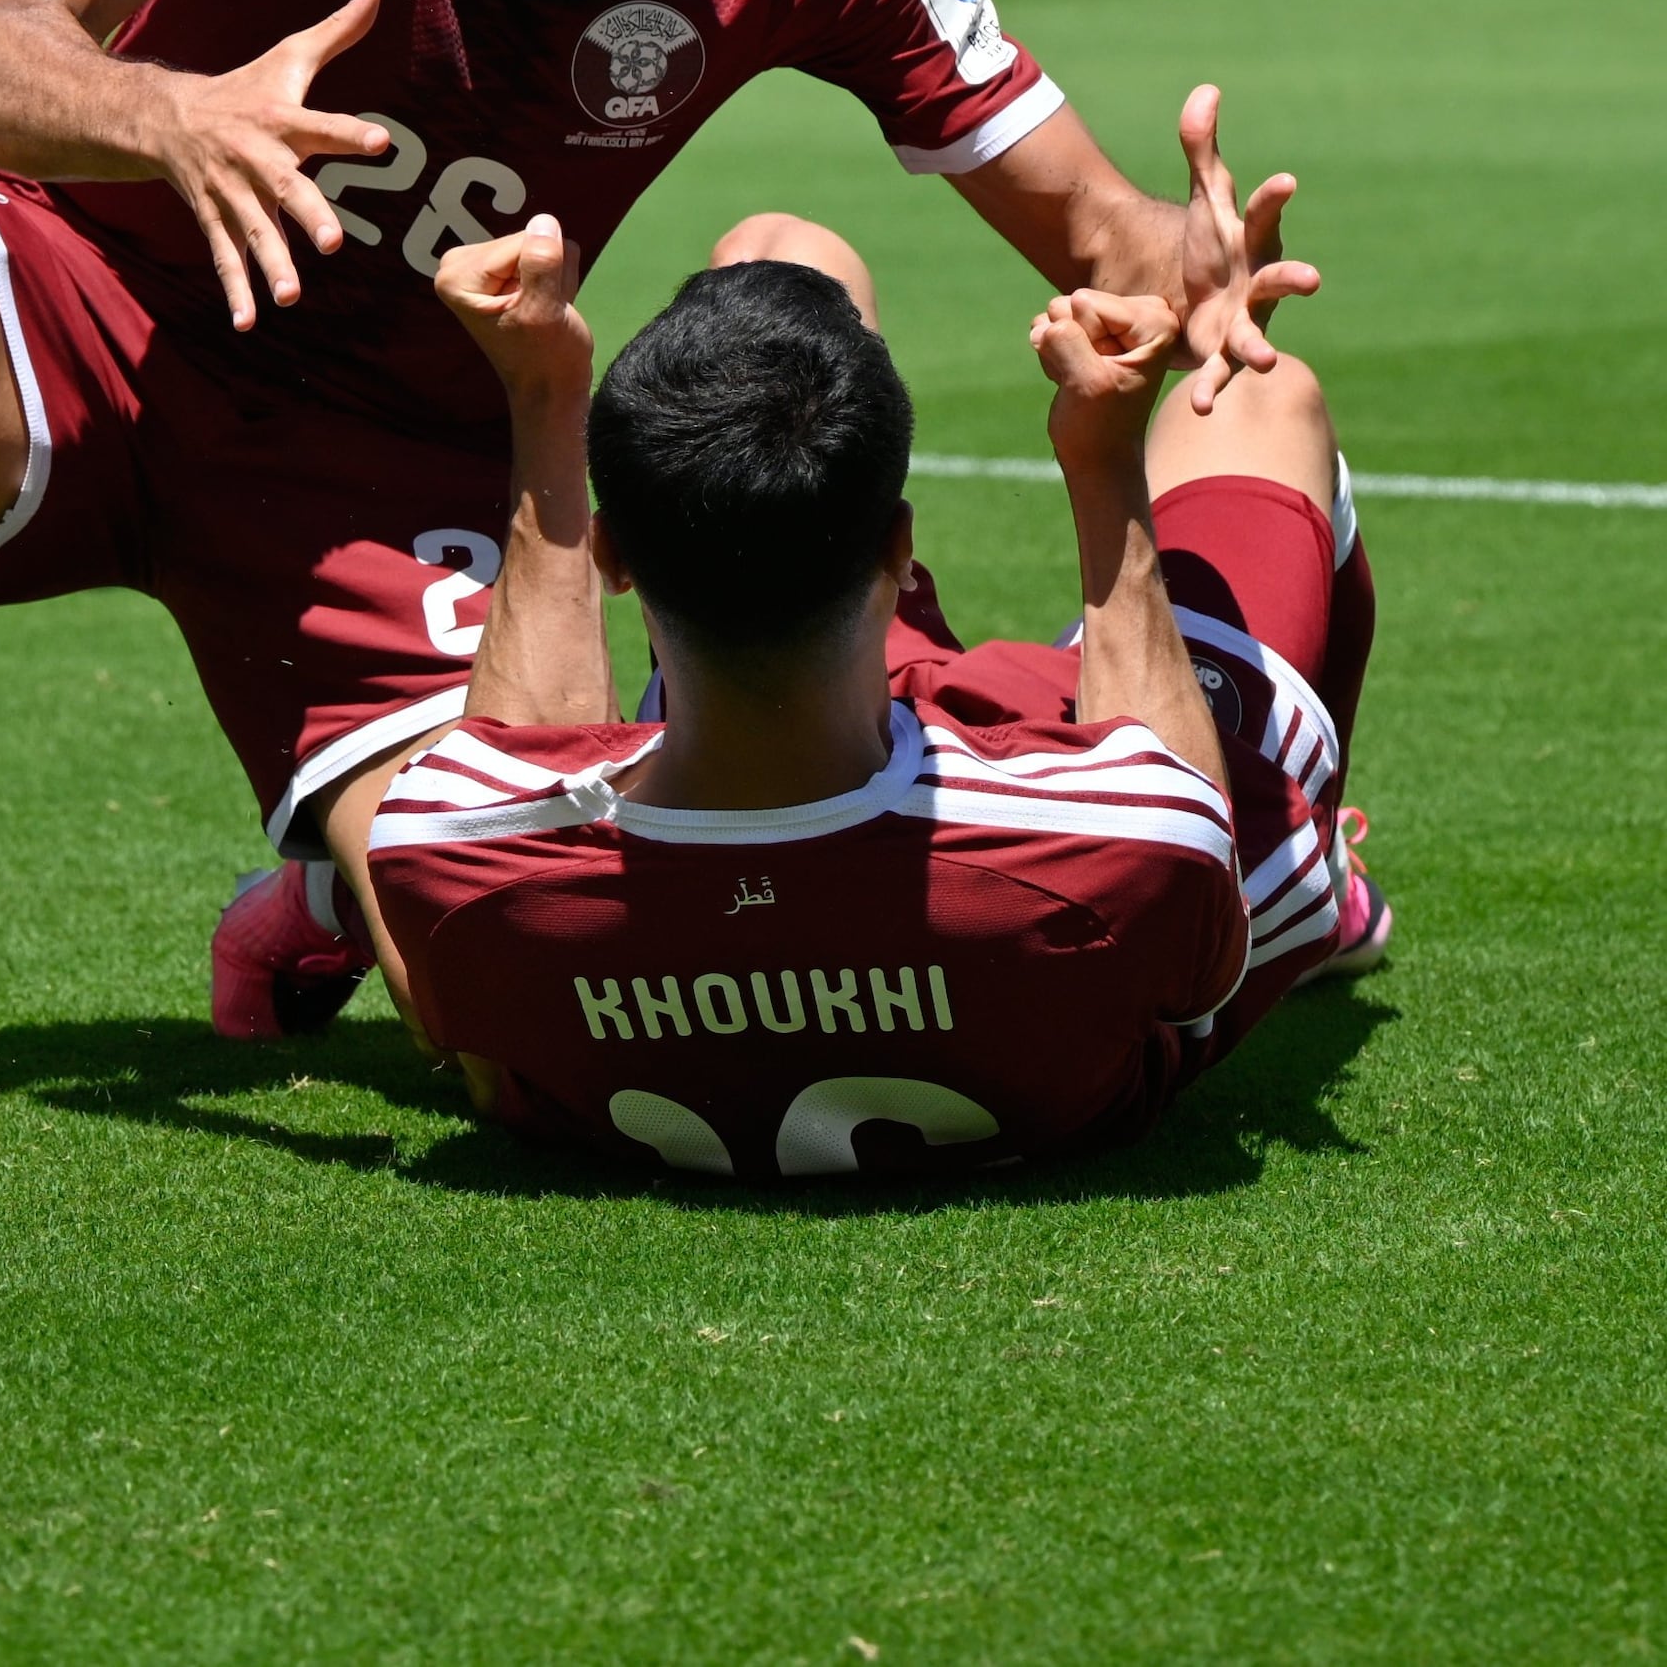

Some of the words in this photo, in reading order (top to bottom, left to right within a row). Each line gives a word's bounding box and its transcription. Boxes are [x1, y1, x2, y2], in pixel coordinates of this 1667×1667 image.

[967, 20, 1000, 52] PEACE
[604, 95, 660, 119] QFA
[315, 112, 581, 295] 26
[413, 528, 502, 656] 2
[573, 964, 954, 1040] KHOUKHI
